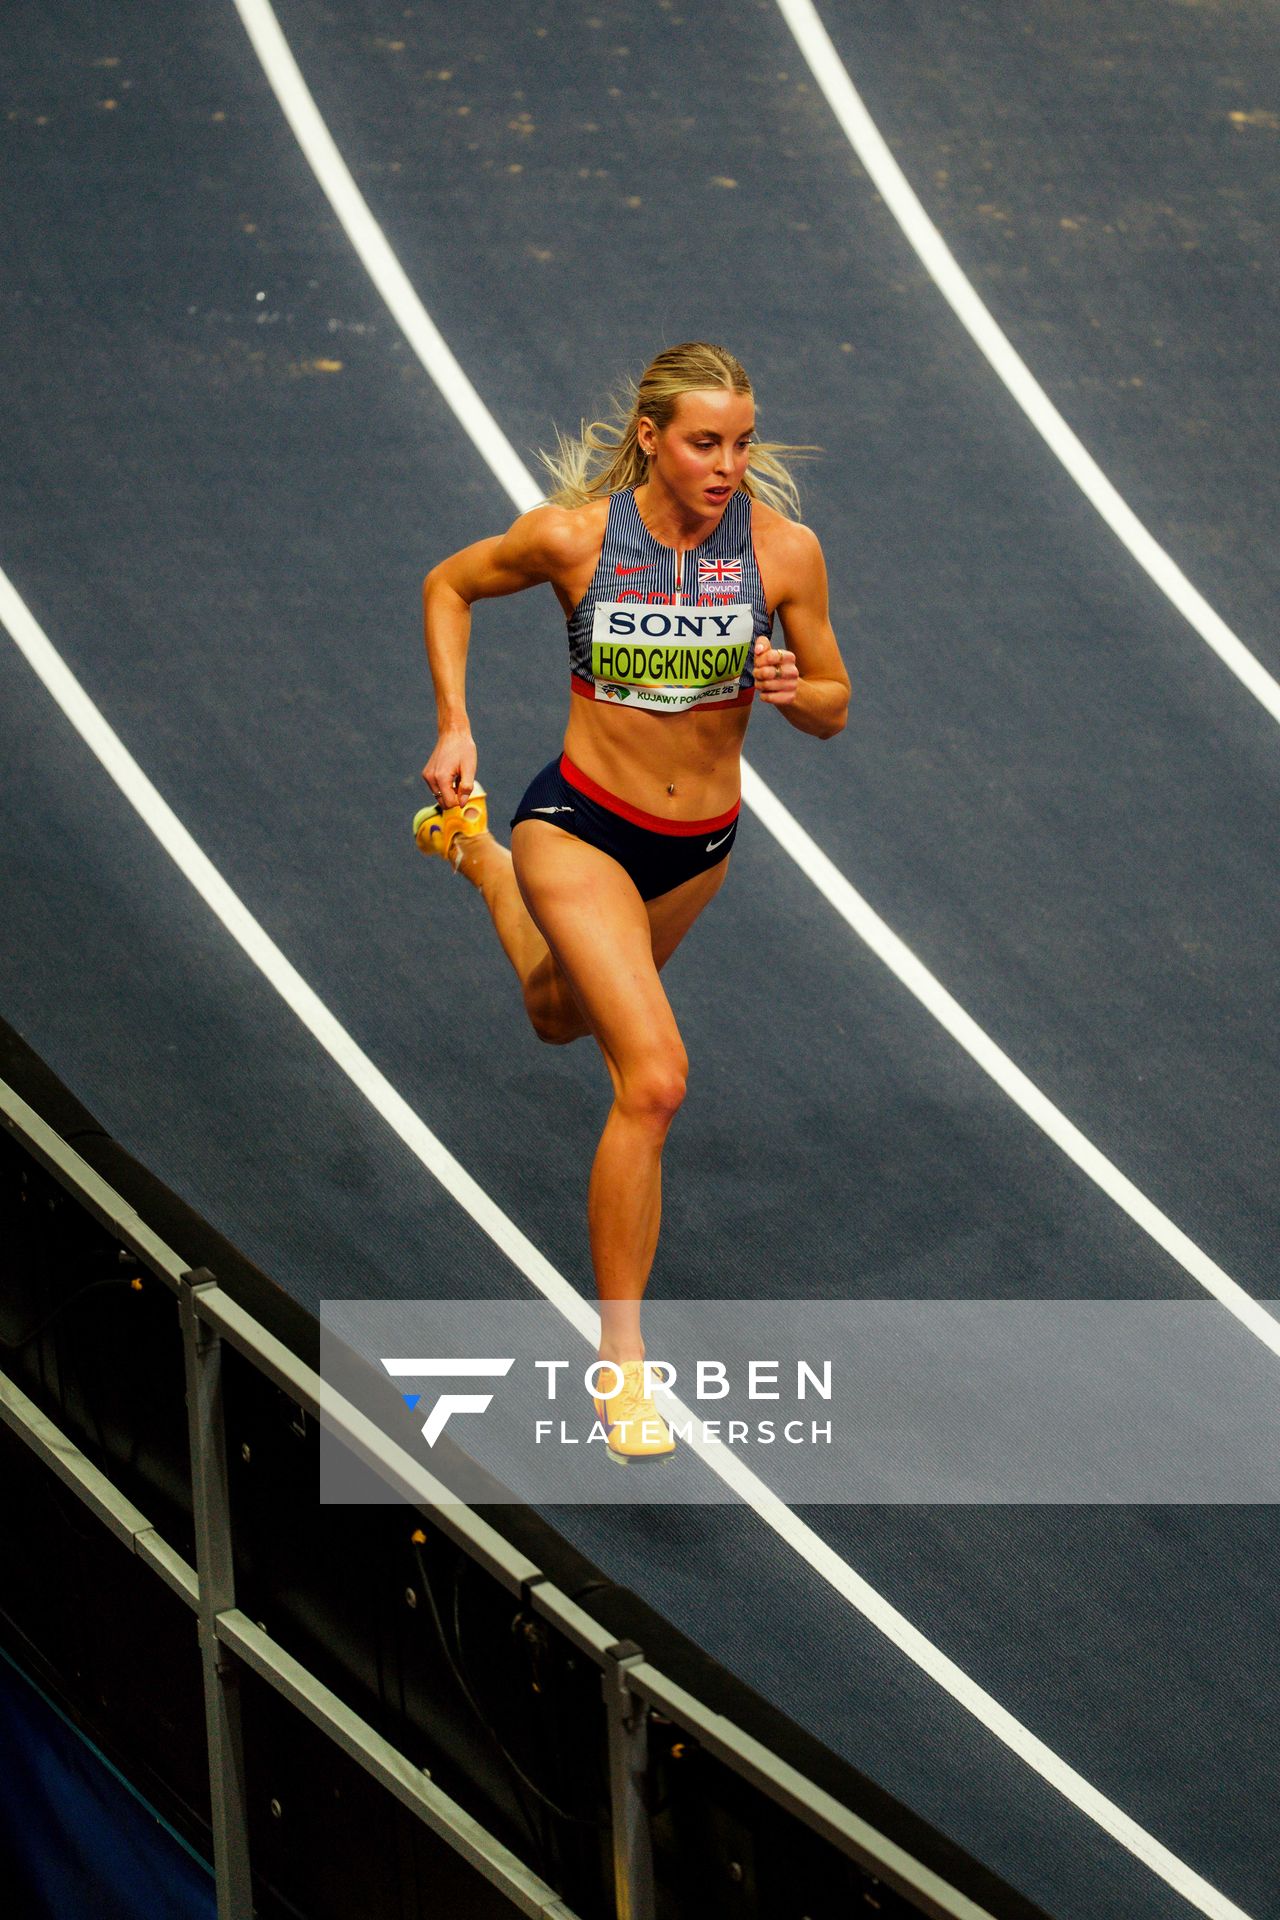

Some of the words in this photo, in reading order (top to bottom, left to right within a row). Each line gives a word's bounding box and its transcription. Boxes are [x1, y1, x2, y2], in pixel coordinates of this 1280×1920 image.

[700, 583, 740, 593] Novuna
[609, 611, 738, 637] SONY
[600, 645, 744, 680] HODGKINSON
[637, 691, 678, 704] KUJAWY
